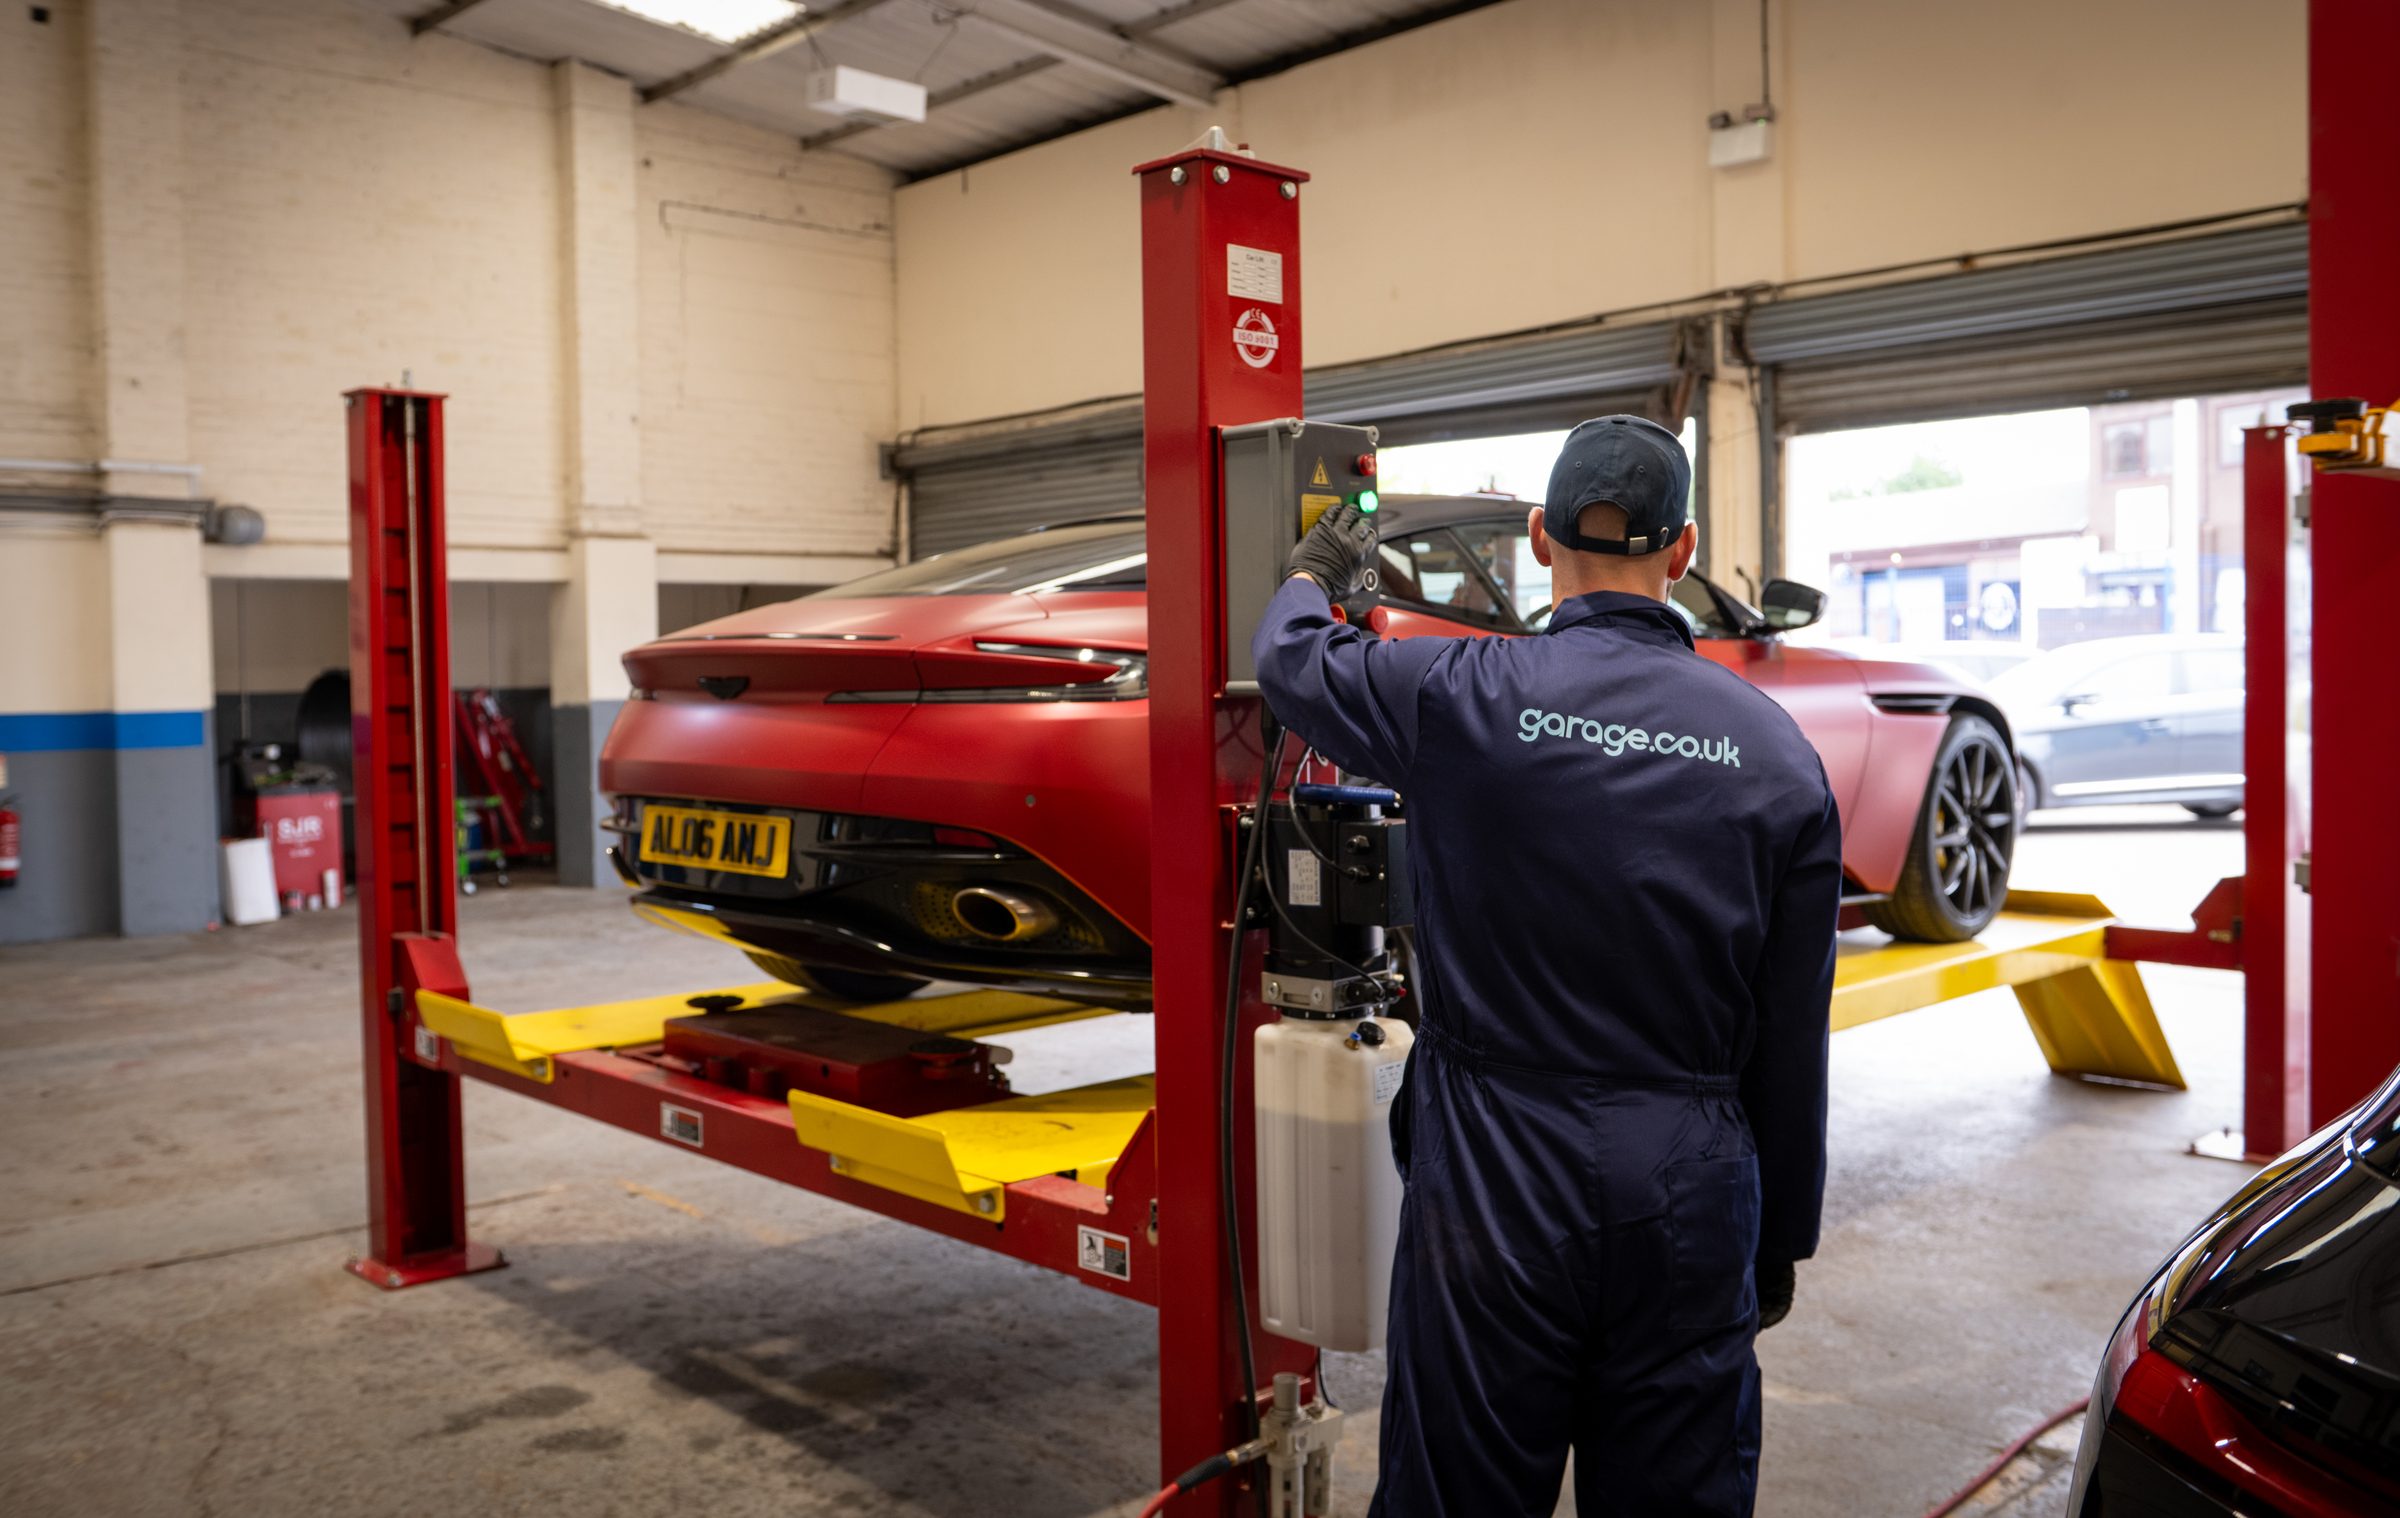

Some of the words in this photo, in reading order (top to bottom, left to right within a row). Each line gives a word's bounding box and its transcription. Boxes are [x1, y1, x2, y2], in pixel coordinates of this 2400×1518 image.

[1238, 332, 1254, 342] ISO
[1255, 334, 1275, 345] 9001
[1517, 708, 1741, 768] garage.co.uk
[719, 820, 777, 867] ANJ
